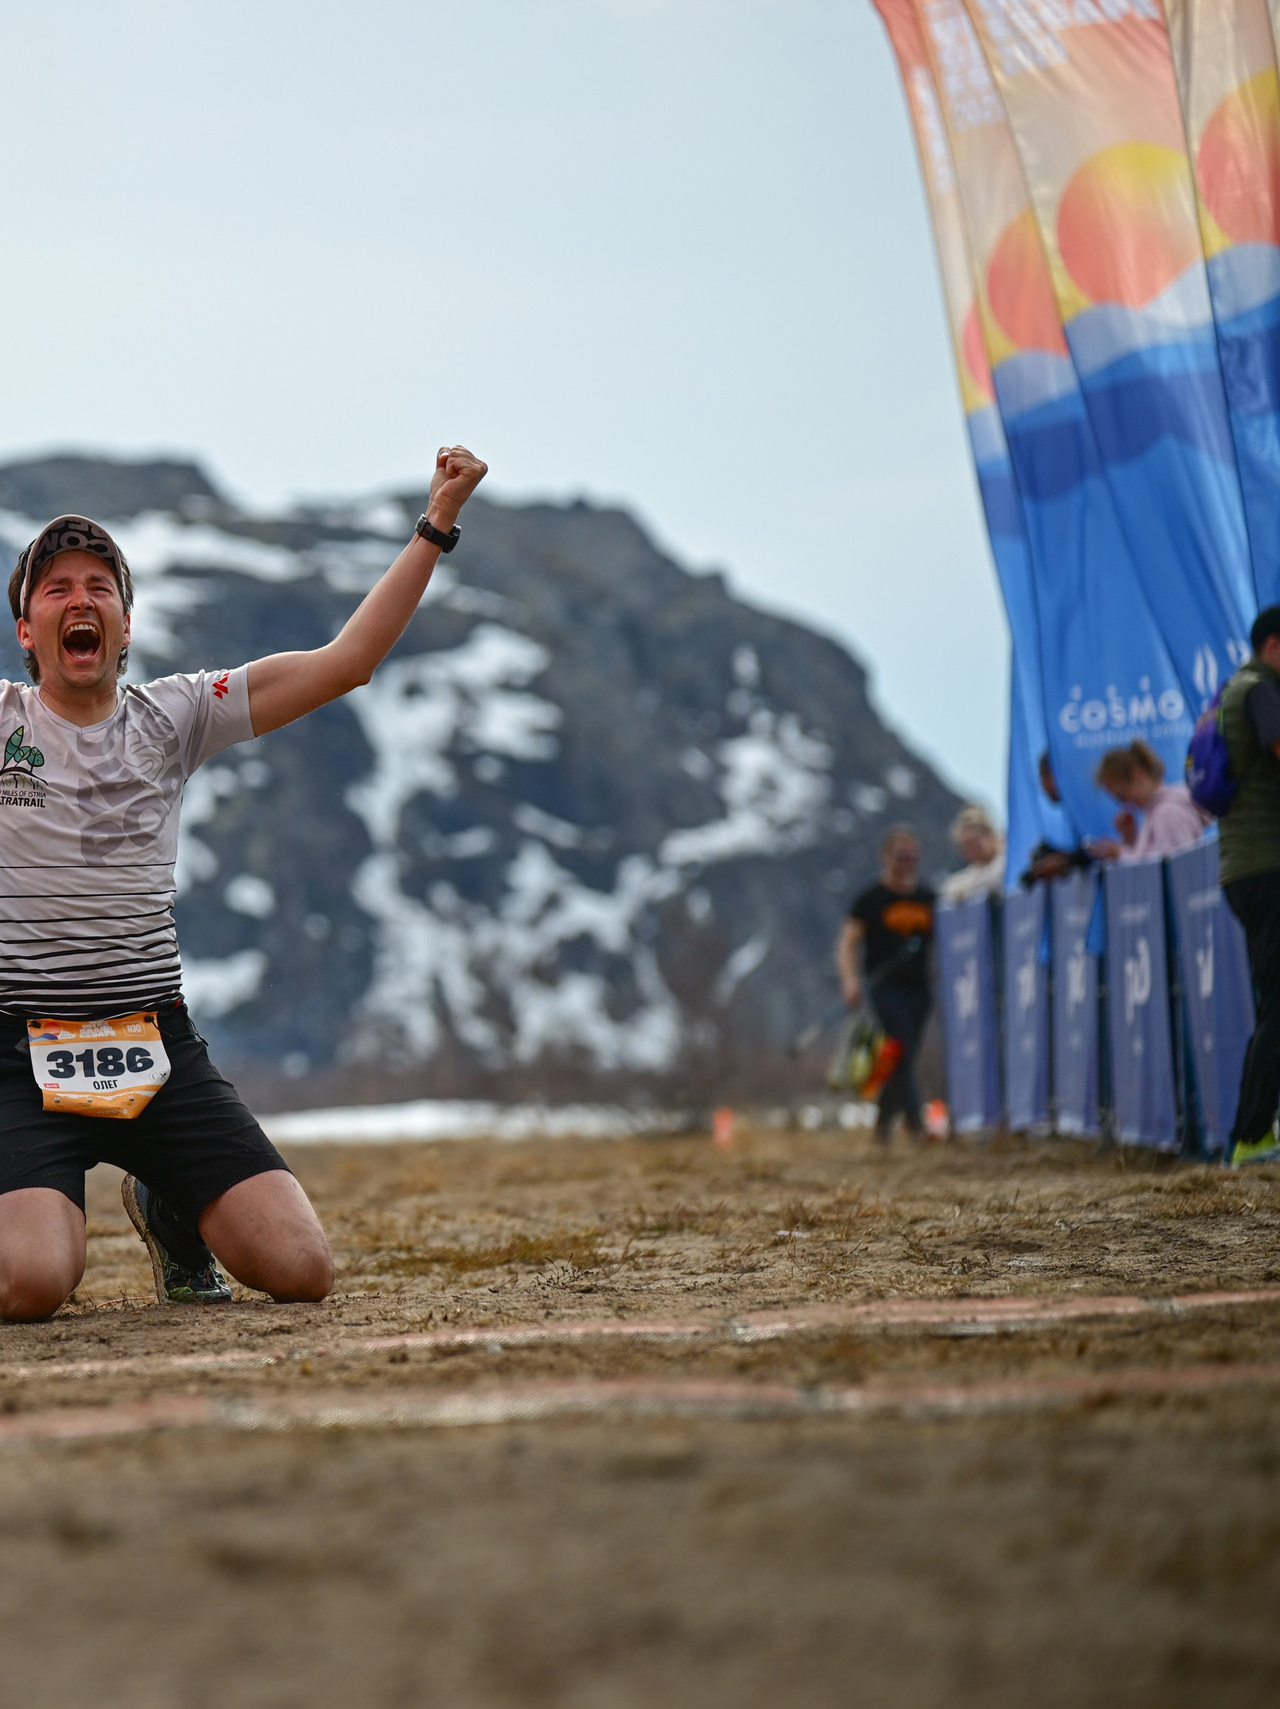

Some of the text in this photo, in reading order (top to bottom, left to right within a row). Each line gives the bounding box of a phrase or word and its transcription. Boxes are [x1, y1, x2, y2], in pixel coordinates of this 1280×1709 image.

[1, 789, 18, 797] MILES
[27, 791, 46, 799] ISTRIA
[46, 1046, 155, 1079] 3186
[92, 1079, 119, 1091] ОЛЕГ
